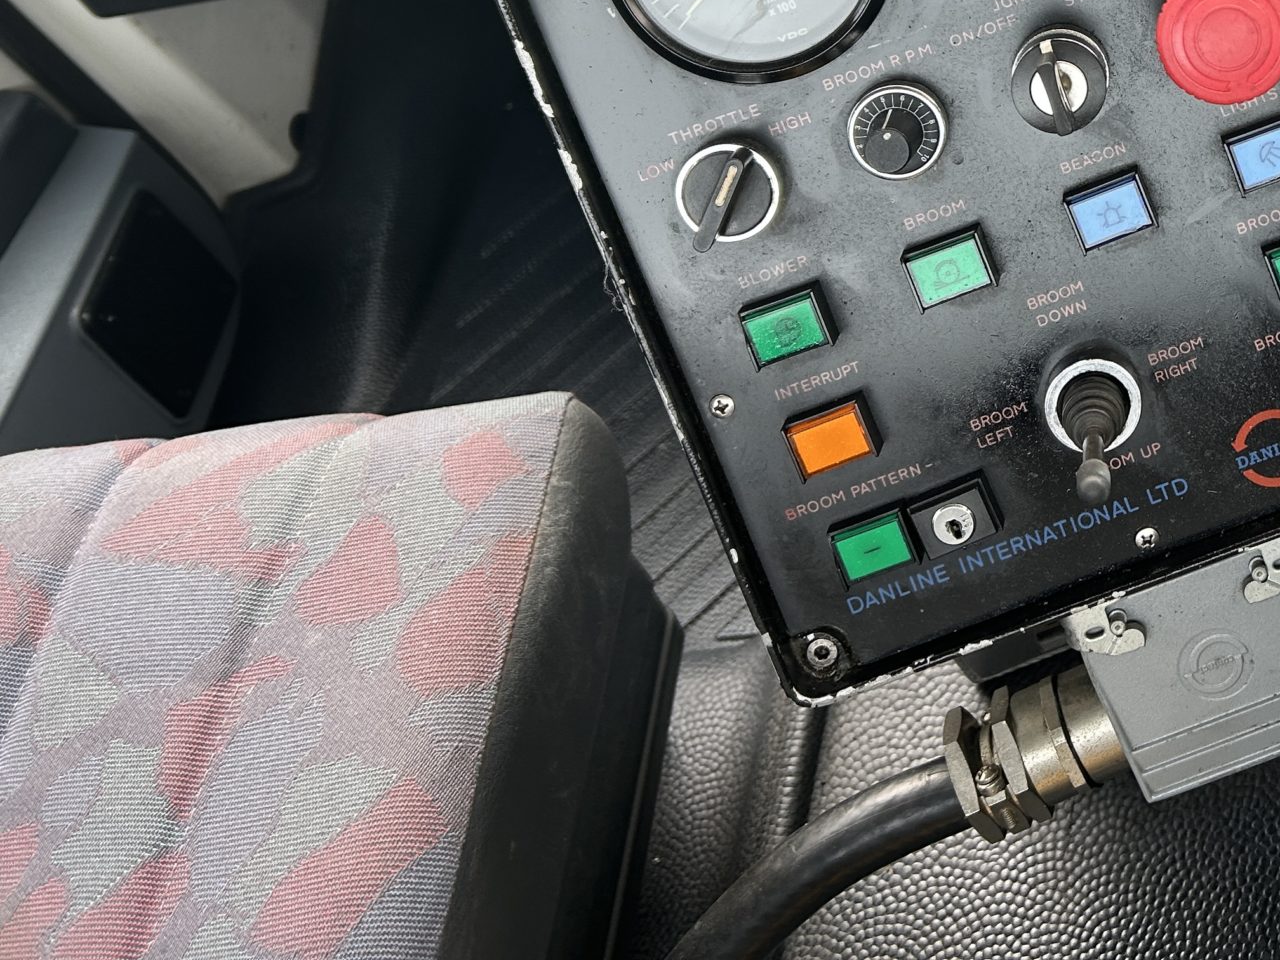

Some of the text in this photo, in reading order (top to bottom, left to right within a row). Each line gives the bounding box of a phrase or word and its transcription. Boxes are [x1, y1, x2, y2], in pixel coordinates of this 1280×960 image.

[777, 0, 797, 14] 100
[950, 13, 1017, 47] ON/OFF
[822, 58, 885, 92] BROOM
[668, 103, 762, 145] THROTTLE
[768, 111, 812, 138] HIGH
[637, 158, 677, 183] LOW
[1060, 142, 1127, 175] BEACON
[904, 199, 966, 231] BROOM
[738, 255, 809, 290] BLOWER
[1026, 280, 1085, 311] BROOM
[1035, 299, 1088, 328] DOWN
[1147, 337, 1205, 367] BROOM
[774, 360, 860, 401] INTERRUPT
[1154, 356, 1199, 384] RIGHT
[969, 401, 1028, 432] BROOM
[976, 425, 1015, 449] LEFT
[1140, 442, 1161, 459] UP
[785, 489, 847, 521] BROOM
[850, 463, 922, 497] PATTERN
[846, 477, 1190, 616] DANLINE INTERNATIONAL LTD
